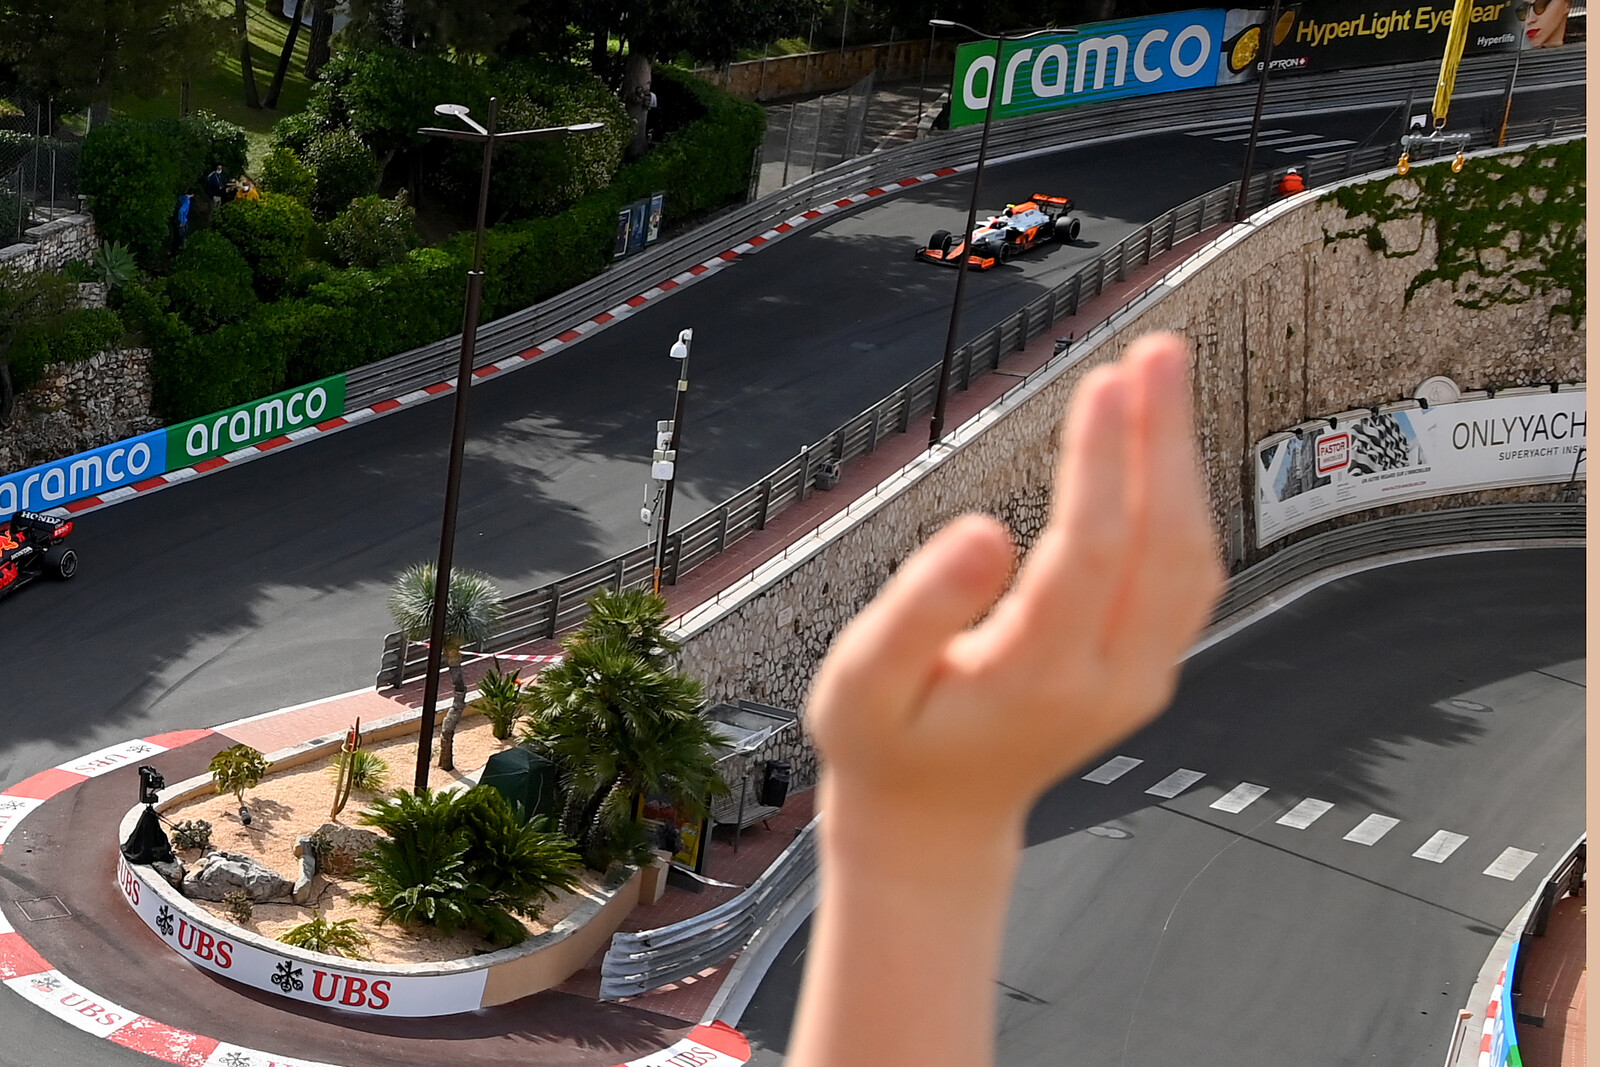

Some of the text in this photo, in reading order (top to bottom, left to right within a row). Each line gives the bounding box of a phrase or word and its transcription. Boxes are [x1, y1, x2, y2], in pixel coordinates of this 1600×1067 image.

[1296, 4, 1504, 48] HyperLight Eyeear
[1477, 33, 1515, 47] Hyperlife
[962, 24, 1211, 110] aramco
[1257, 58, 1299, 70] BPTRON
[186, 386, 327, 457] aramco
[1499, 446, 1559, 461] SUPERYACHT
[118, 862, 141, 906] UBS
[178, 918, 234, 970] UBS
[60, 992, 123, 1026] UBS
[311, 970, 392, 1011] UBS
